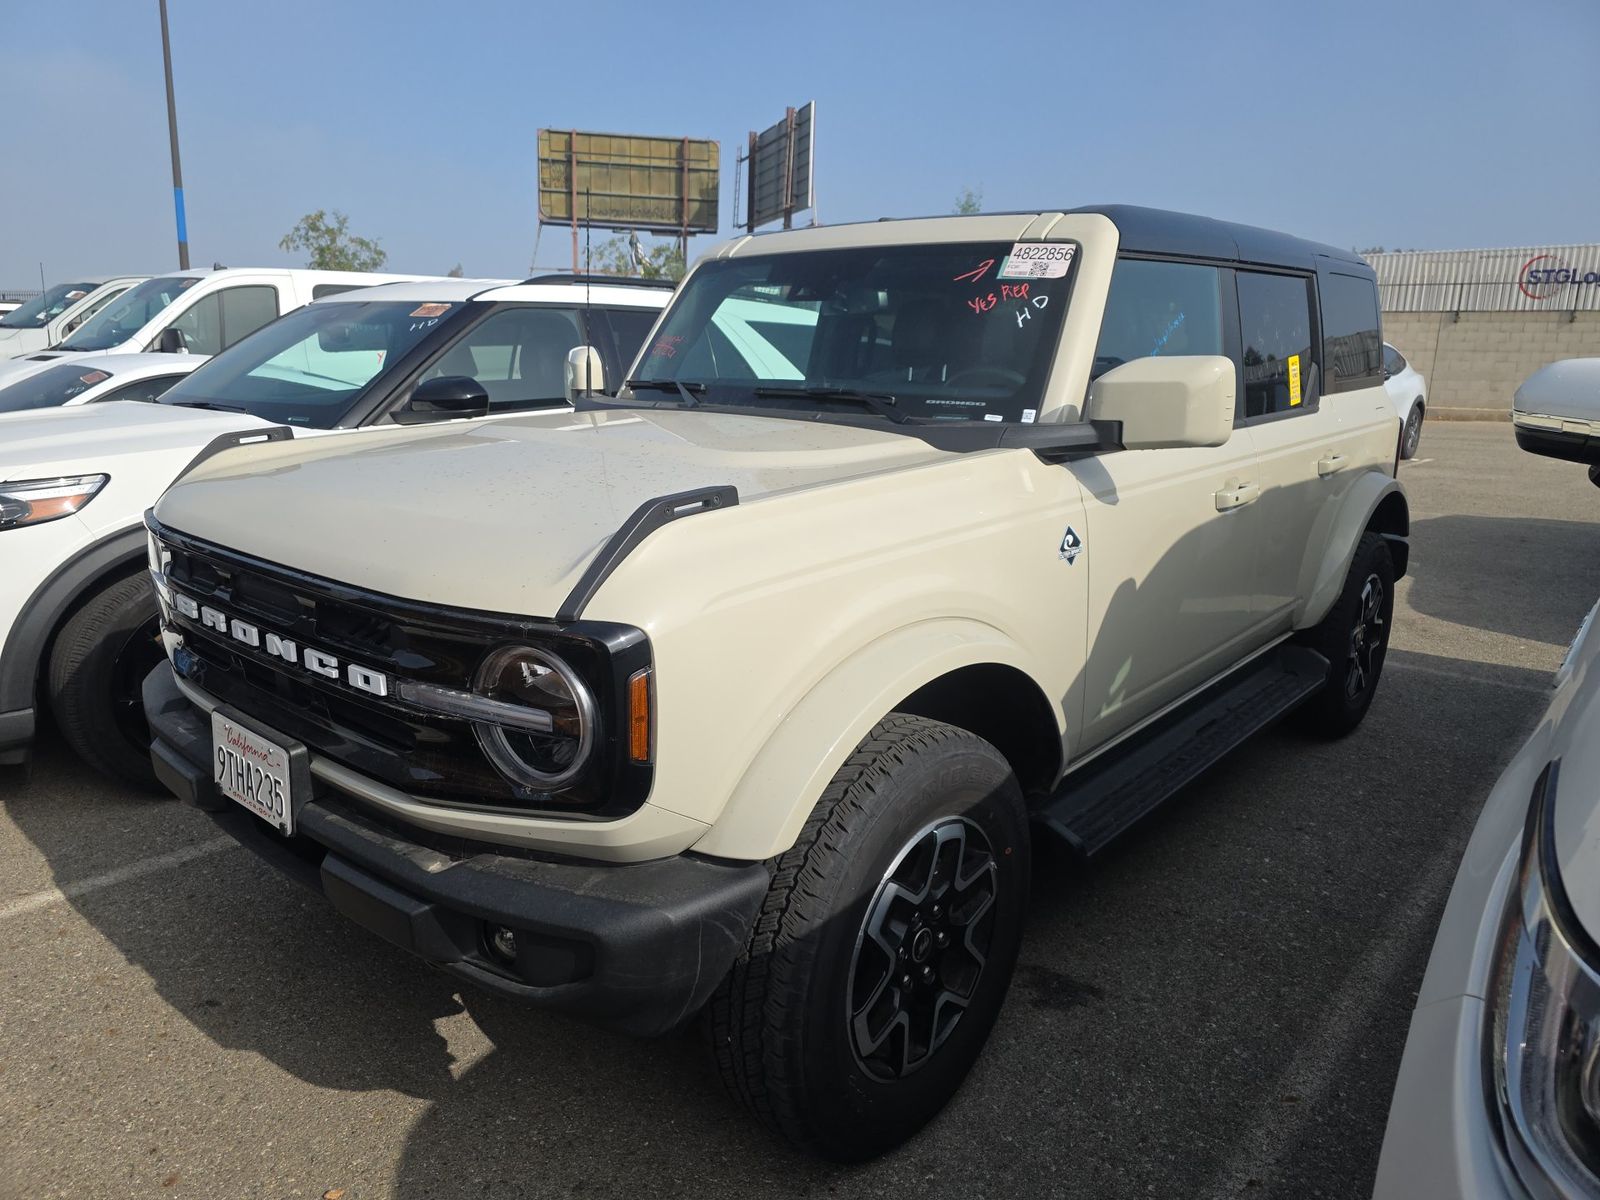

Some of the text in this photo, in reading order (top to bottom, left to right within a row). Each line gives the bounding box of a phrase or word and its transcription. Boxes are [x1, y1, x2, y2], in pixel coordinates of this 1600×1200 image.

[1013, 247, 1075, 261] 4822856
[967, 282, 1030, 314] YES REP
[176, 593, 388, 697] BRONCO
[226, 726, 274, 768] California
[217, 744, 285, 819] 9THA235
